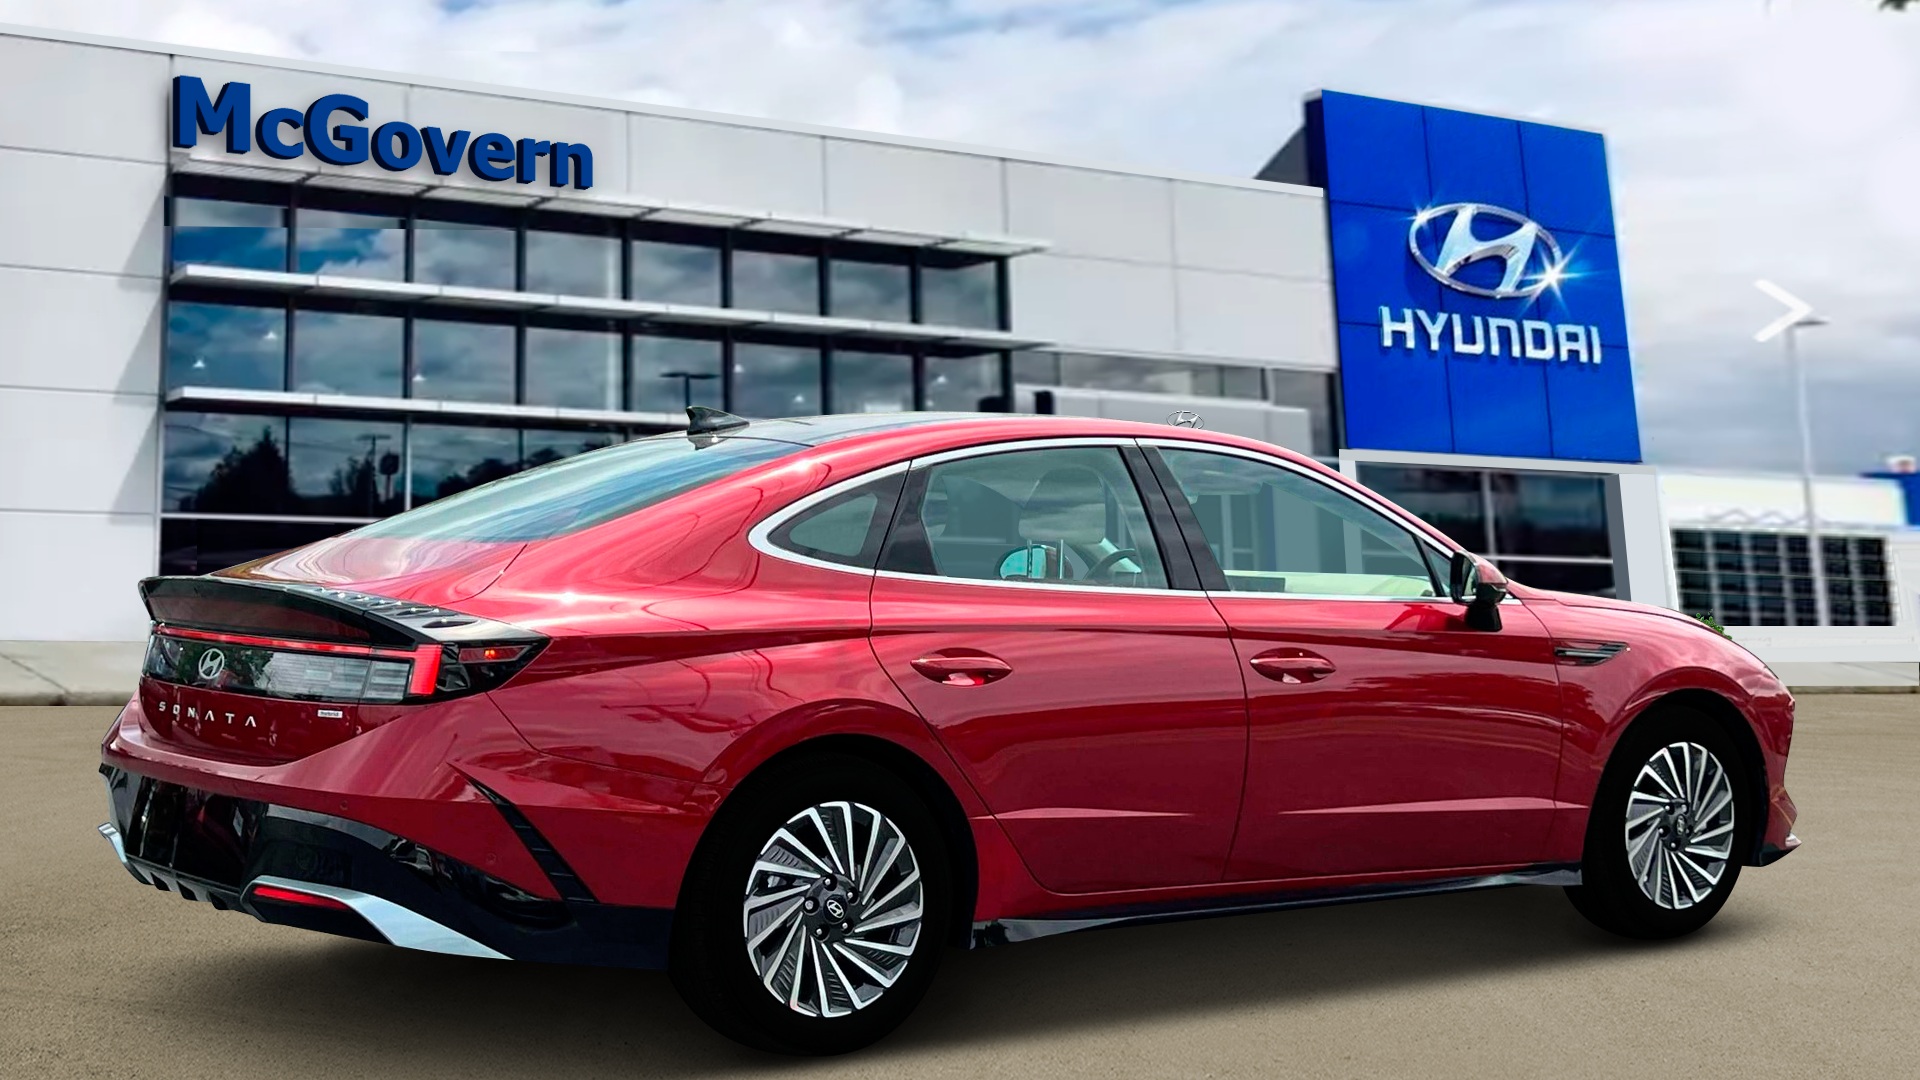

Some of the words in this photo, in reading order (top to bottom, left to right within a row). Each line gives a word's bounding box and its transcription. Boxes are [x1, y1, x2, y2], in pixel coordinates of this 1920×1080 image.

[172, 75, 593, 190] McGovern
[1379, 305, 1602, 364] HYUNDAI
[158, 701, 257, 728] SONATA
